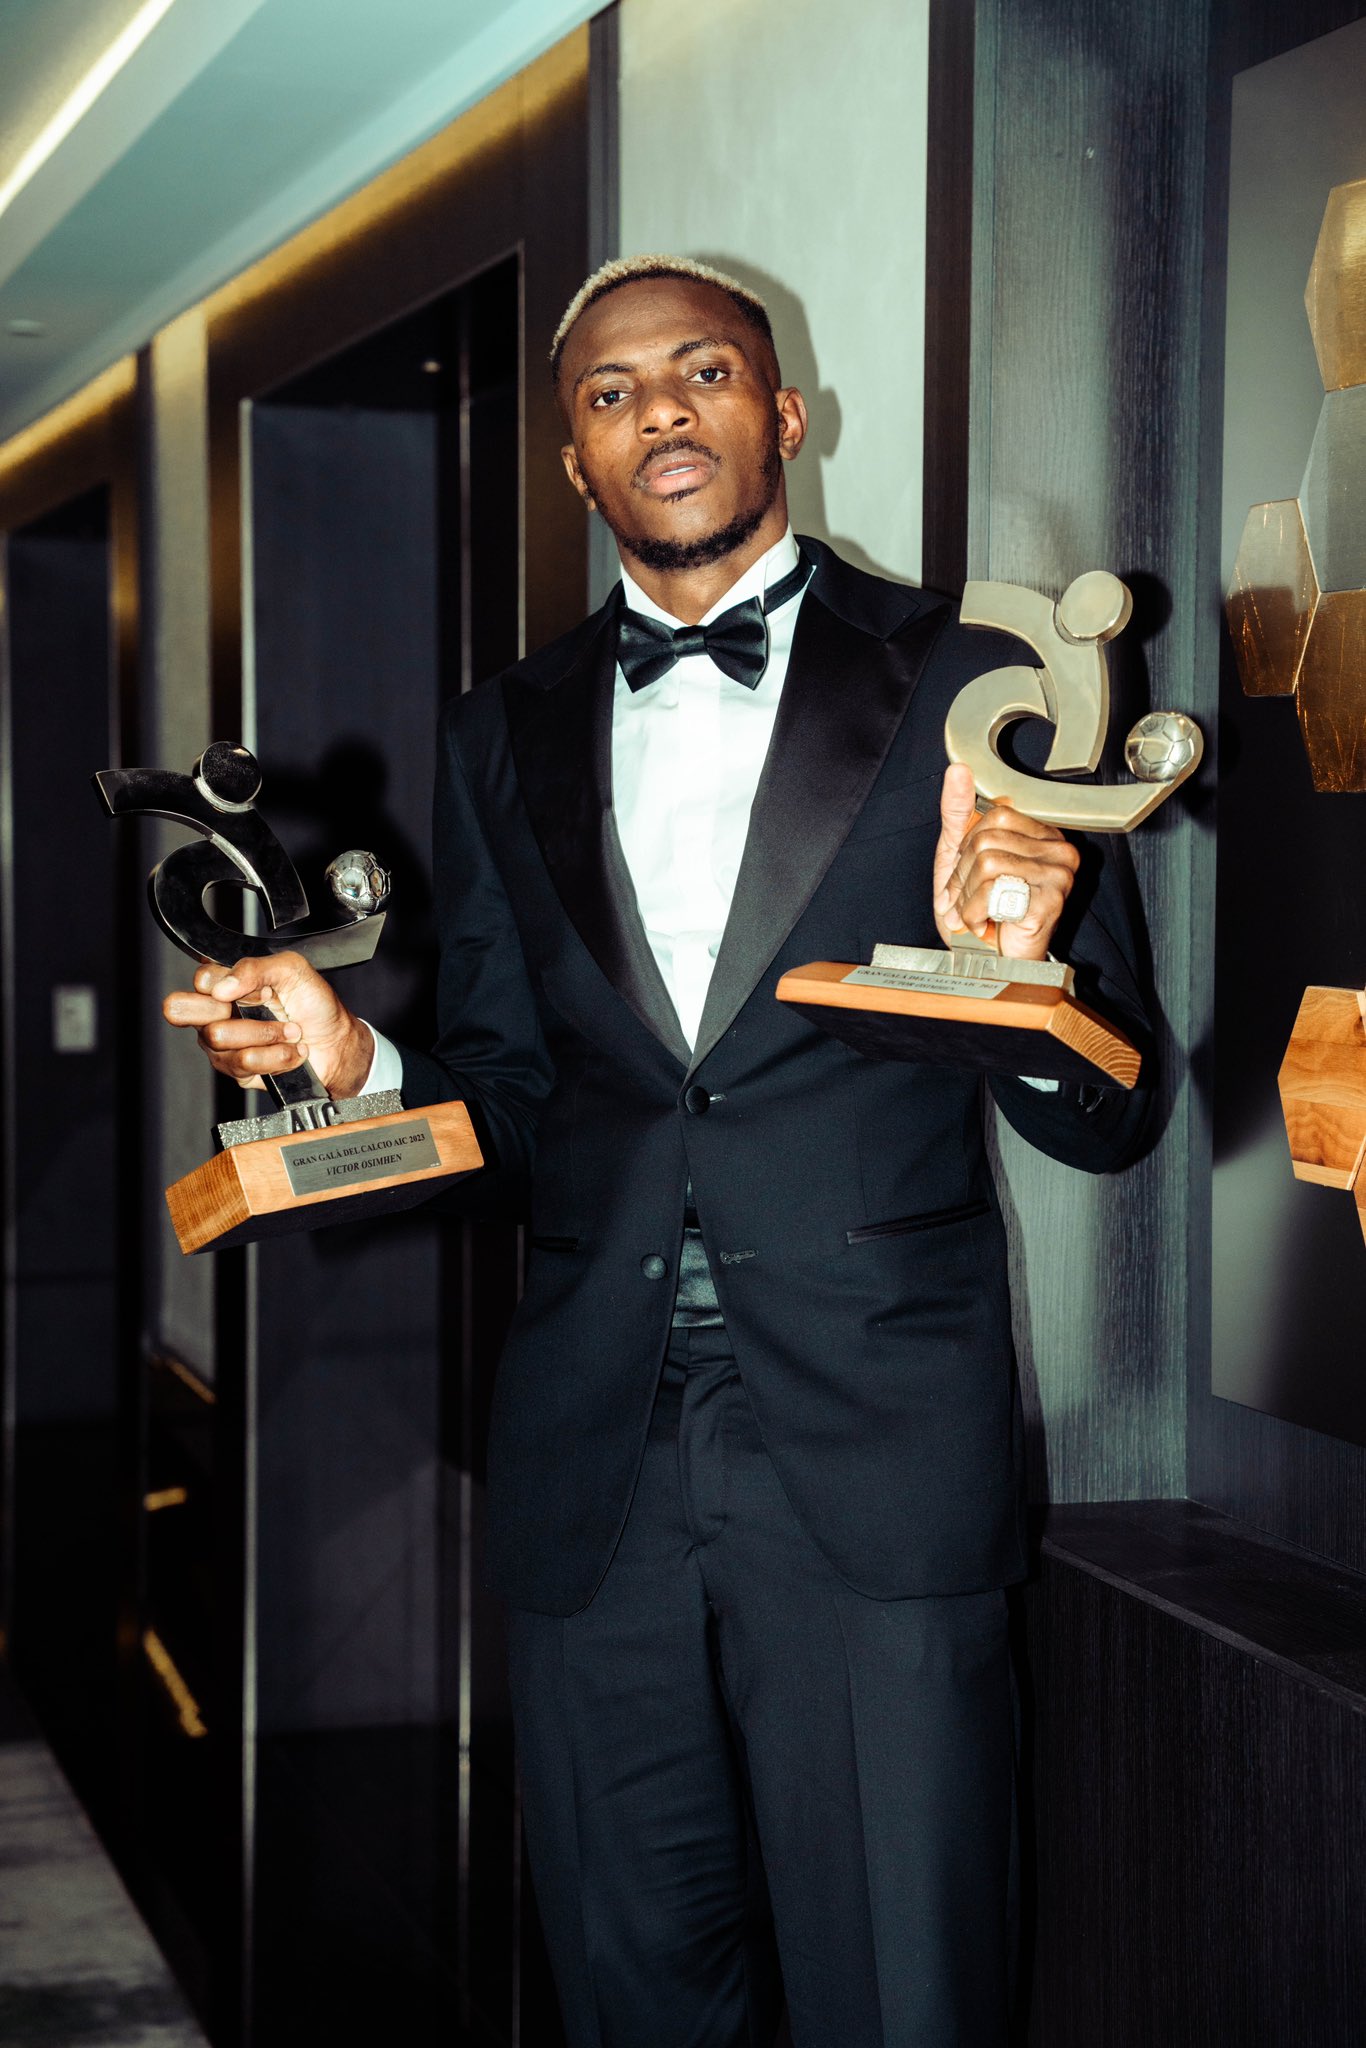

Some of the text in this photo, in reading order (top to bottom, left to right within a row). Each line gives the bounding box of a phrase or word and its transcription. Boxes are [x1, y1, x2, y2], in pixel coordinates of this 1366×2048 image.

[289, 1102, 342, 1133] AIC
[293, 1133, 426, 1167] GRAN GALÀ DEL CALCIO AIC 2023
[326, 1153, 402, 1175] VICTOR OSIMHEN
